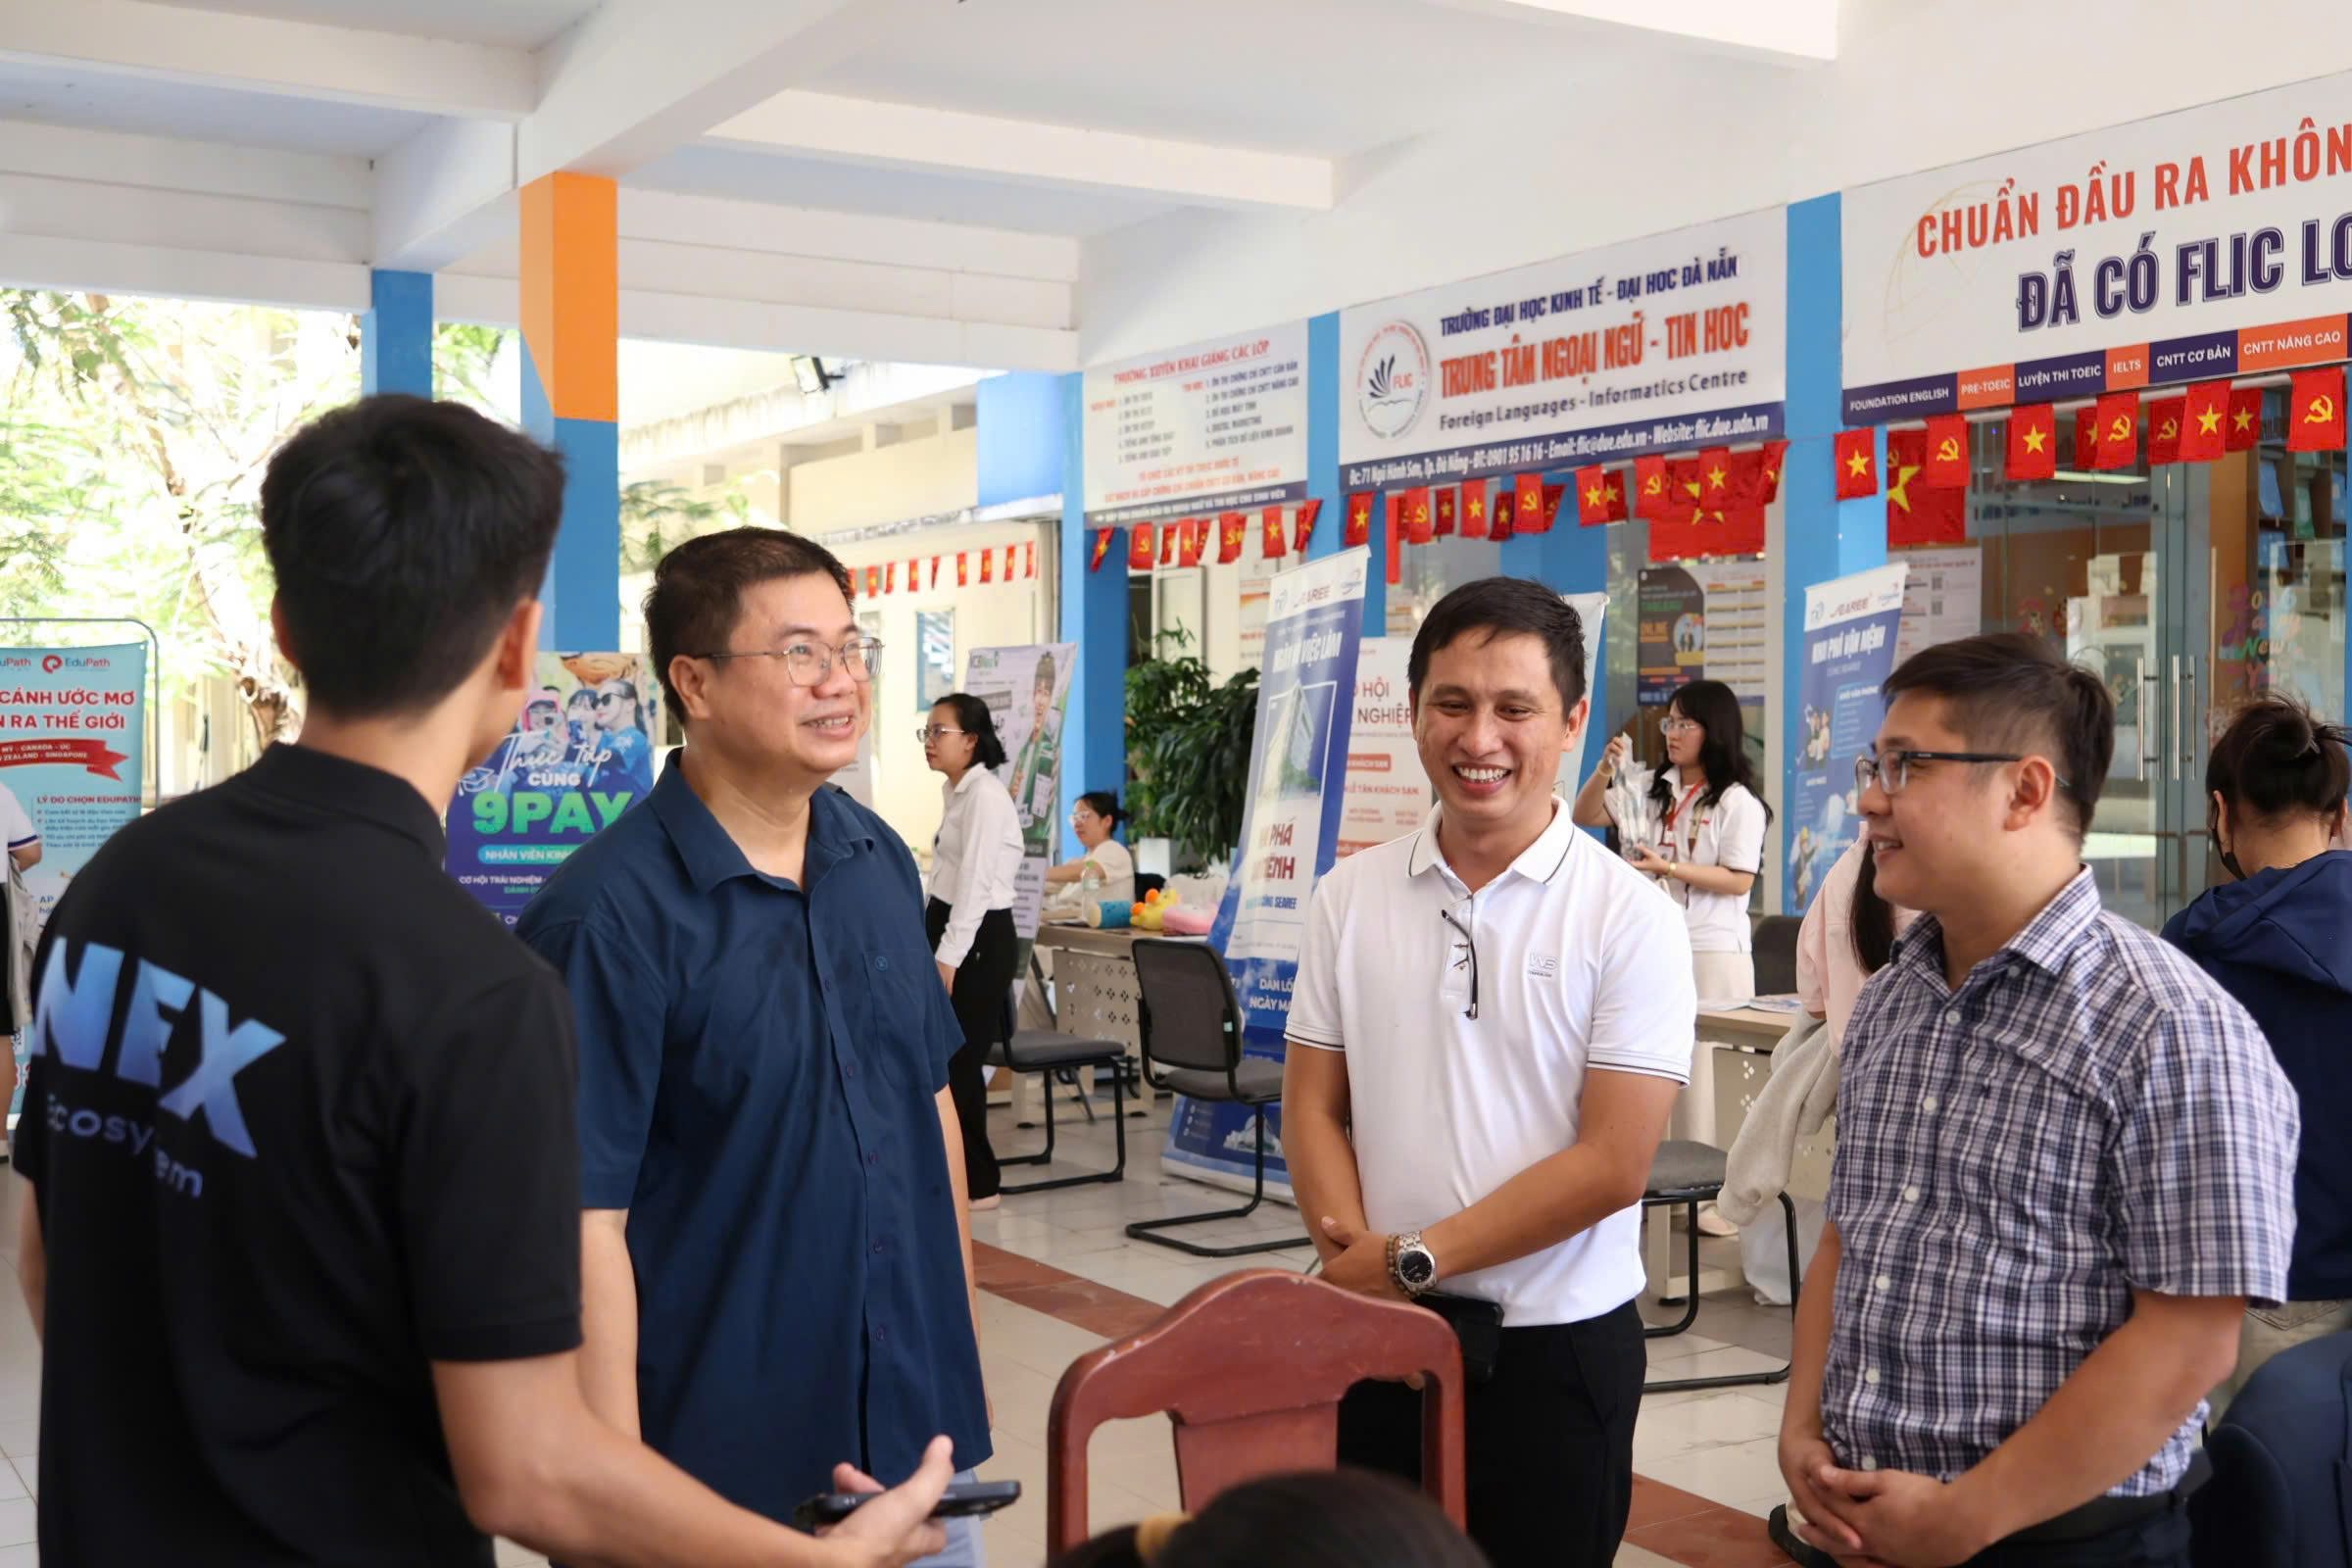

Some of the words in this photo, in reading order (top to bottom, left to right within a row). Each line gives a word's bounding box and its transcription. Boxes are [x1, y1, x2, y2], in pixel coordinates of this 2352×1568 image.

[1917, 176, 2038, 259] CHUẨN
[2056, 160, 2134, 230] ĐẦU
[2155, 156, 2209, 211] RA
[2230, 117, 2352, 196] KHÔN
[2016, 248, 2081, 333] ĐÃ
[2094, 230, 2159, 319] CÓ
[2176, 226, 2284, 307] FLIC
[1494, 303, 1515, 329] ĐẠI
[1519, 296, 1547, 324] HỌC
[1550, 287, 1583, 315] KINH
[1588, 275, 1605, 307] TẾ
[1617, 275, 1642, 303] ĐẠI
[1682, 257, 1702, 287] ĐÀ
[1441, 351, 1496, 399] TRUNG
[1500, 333, 1537, 388] TÂM
[1542, 331, 1597, 385] NGOẠI
[1604, 310, 1644, 370] NGỮ
[1665, 312, 1697, 361] TIN
[2243, 340, 2276, 356] CNTT
[2277, 333, 2313, 350] NÂNG
[2315, 330, 2341, 345] CAO
[2113, 360, 2141, 373] IELTS
[2156, 353, 2186, 368] CNTT
[2187, 348, 2205, 363] CƠ
[2207, 344, 2231, 362] BẢN
[1960, 377, 2011, 395] PRE-TOEIC
[2018, 370, 2050, 388] LUYỆN
[2052, 368, 2070, 383] THI
[2071, 365, 2102, 380] TOEIC
[1441, 409, 1494, 431] Foreign
[1496, 396, 1577, 421] Languages
[1590, 378, 1685, 407] Informatics
[1689, 369, 1748, 390] Centre
[1850, 392, 1908, 412] FOUNDATION
[1909, 387, 1949, 404] ENGLISH
[1508, 445, 1519, 465] 95
[1521, 443, 1532, 463] 16
[1533, 442, 1544, 461] 16
[1653, 421, 1693, 445] Website:
[65, 658, 110, 667] EduPath
[58, 687, 99, 705] ƯỚC
[104, 690, 135, 705] MƠ
[1362, 676, 1390, 703] HỘI
[11, 715, 37, 728] RA
[43, 709, 80, 729] THẾ
[84, 711, 125, 729] GIỚI
[527, 768, 581, 787] CÙNG
[472, 791, 633, 835] 9PAY
[485, 848, 518, 860] NHÂN
[519, 847, 545, 860] VIÊN
